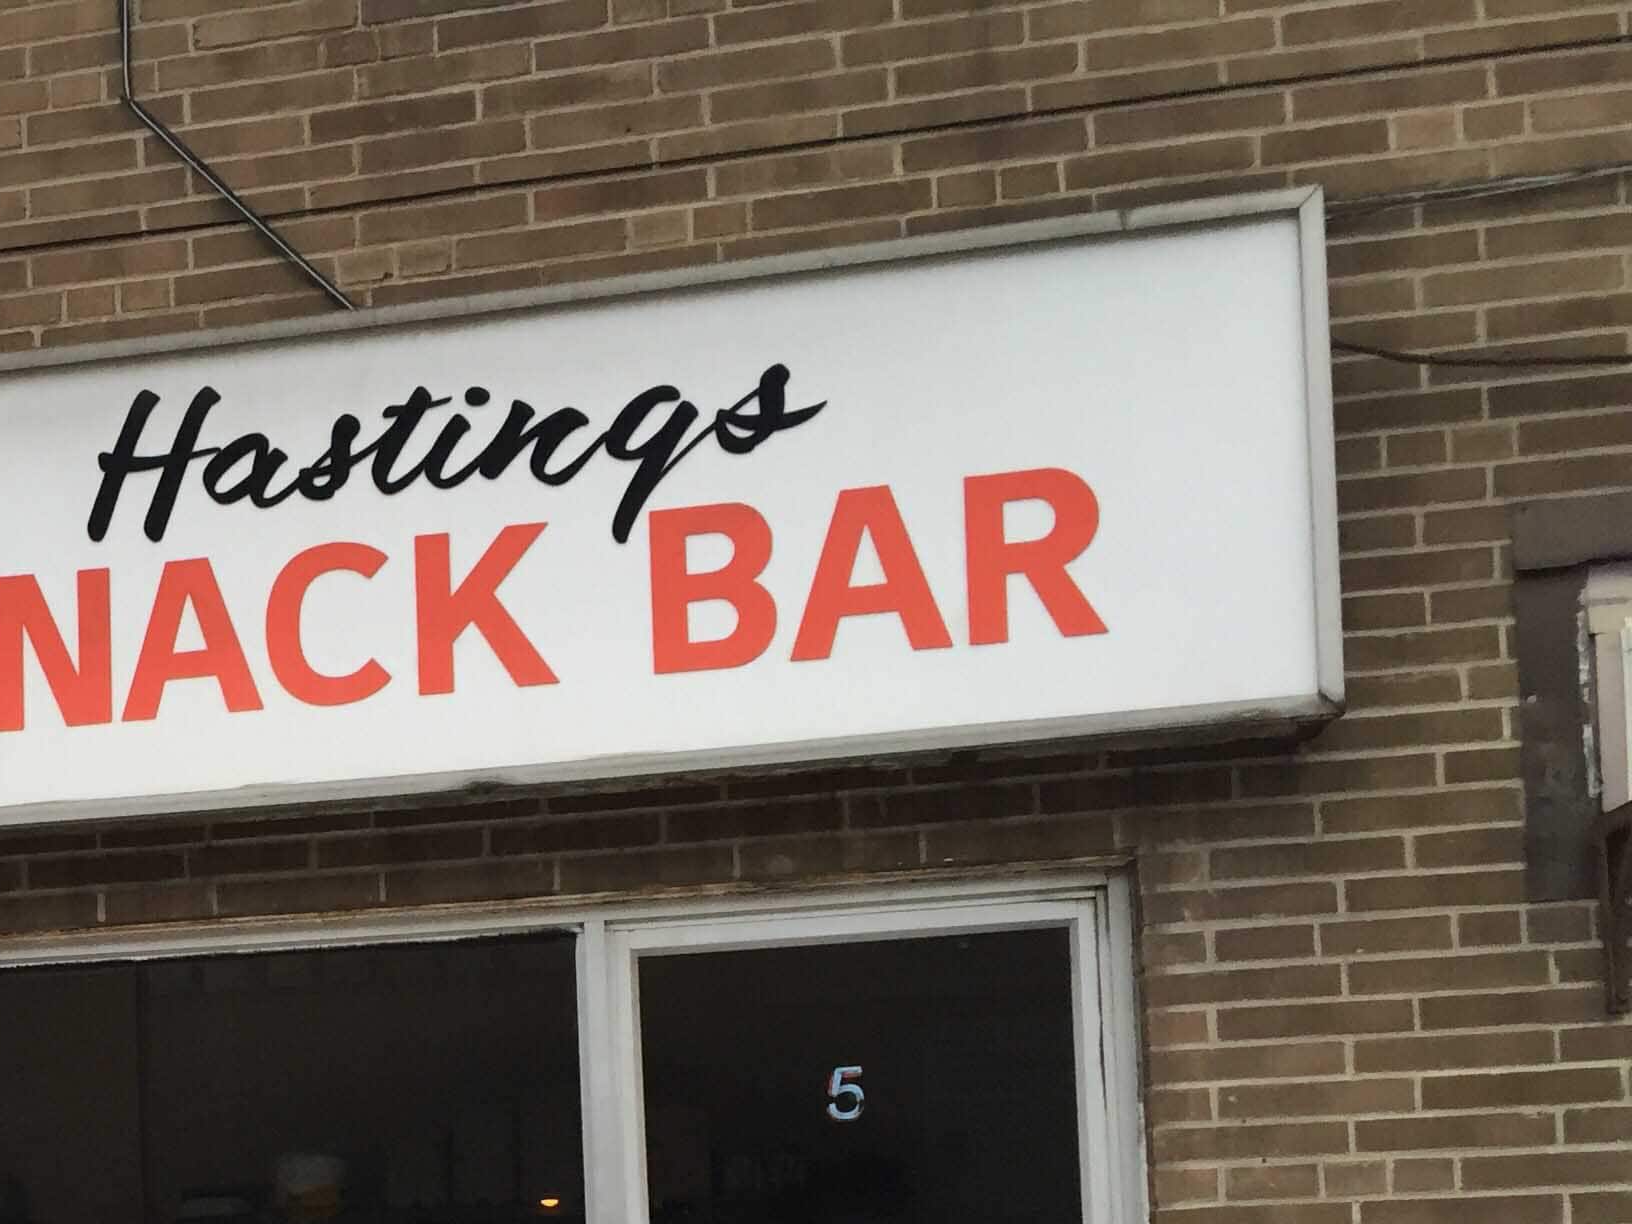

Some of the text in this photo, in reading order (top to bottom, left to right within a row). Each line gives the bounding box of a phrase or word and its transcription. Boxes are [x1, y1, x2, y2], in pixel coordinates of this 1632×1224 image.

[86, 362, 828, 545] Hastings
[648, 467, 1108, 675] BAR
[825, 1065, 865, 1121] 5
